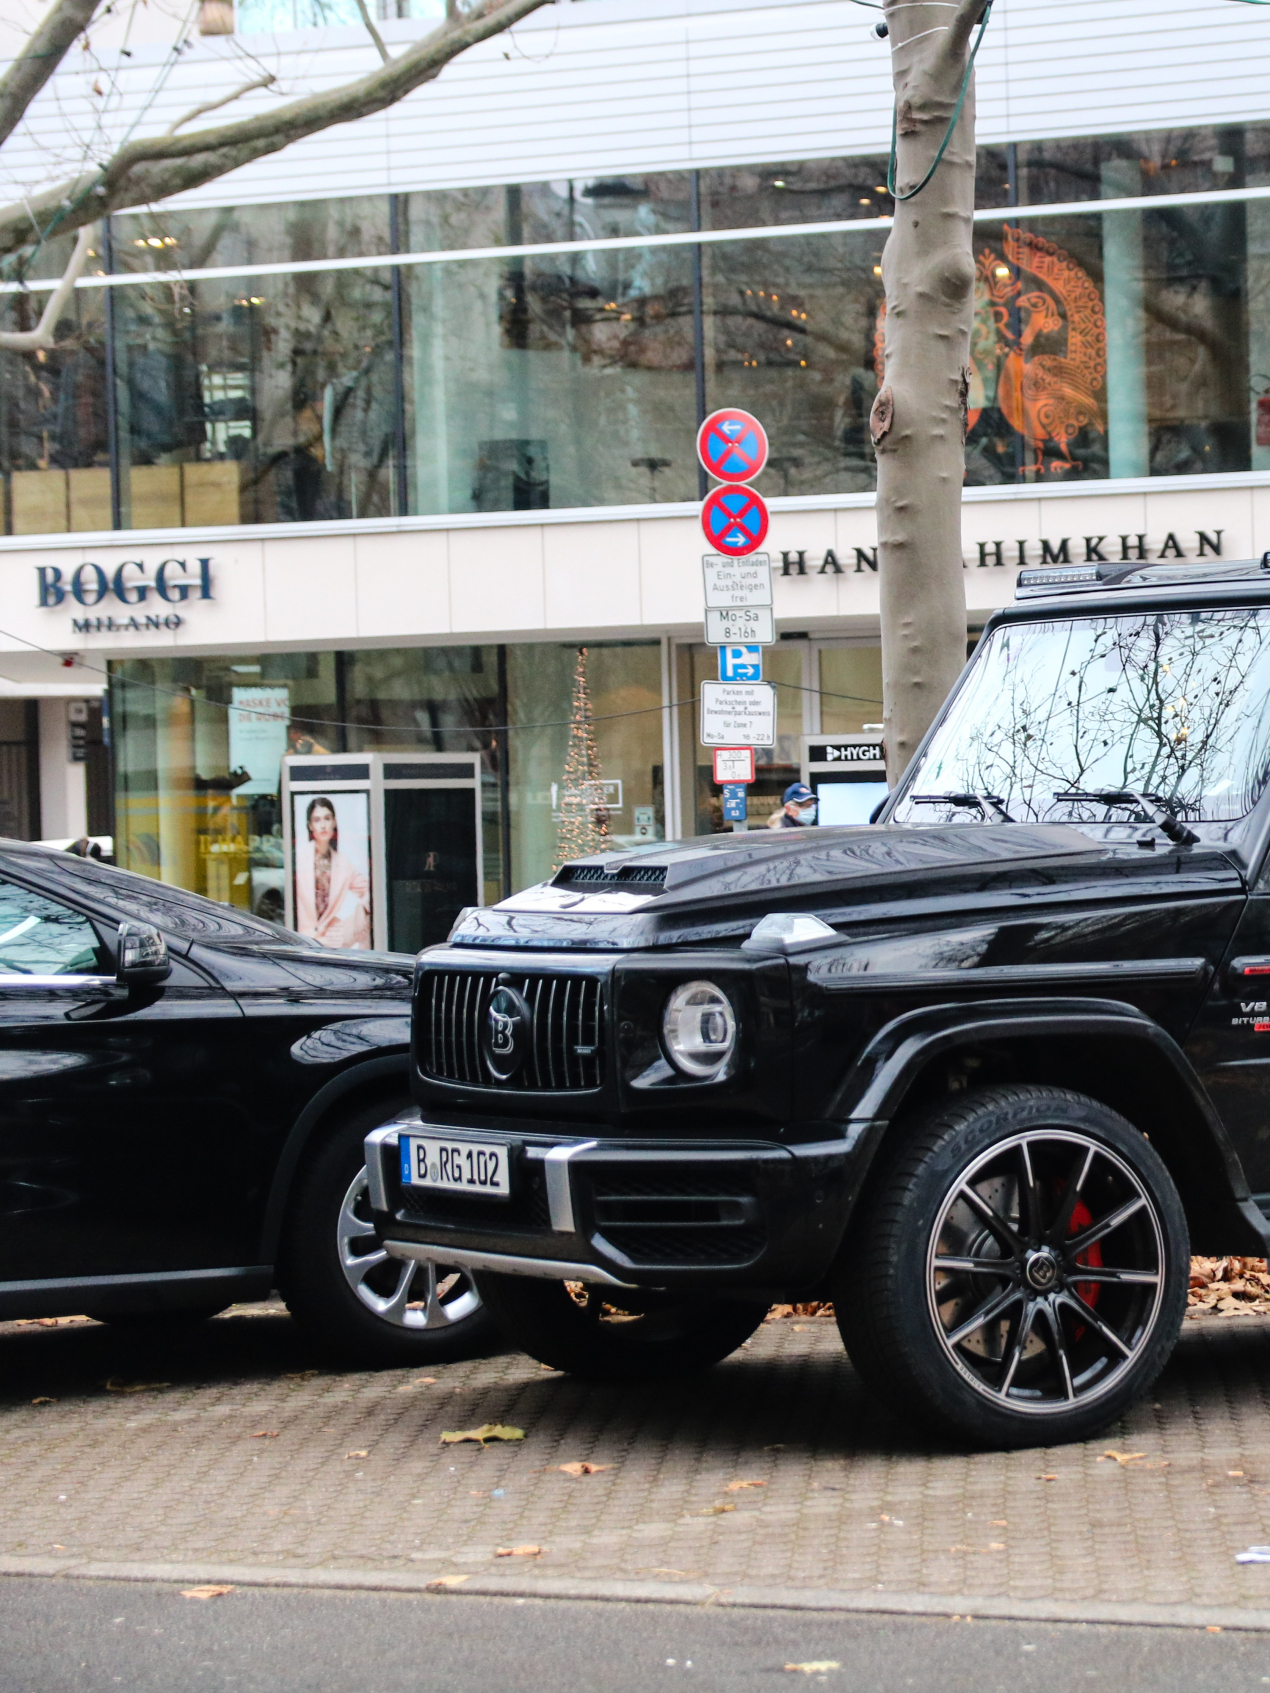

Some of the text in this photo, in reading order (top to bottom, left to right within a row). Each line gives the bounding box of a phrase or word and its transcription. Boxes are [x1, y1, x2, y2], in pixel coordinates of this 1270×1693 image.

[780, 529, 1225, 576] HAN HIMKHAN
[717, 570, 758, 580] Ein- und
[35, 557, 215, 608] BOGGI
[712, 582, 765, 593] Aussteigen
[731, 594, 747, 602] frei
[719, 610, 759, 622] Mo-Sa
[71, 613, 183, 634] MILANO
[724, 627, 756, 639] 8-16h
[841, 746, 880, 760] HYGH
[1240, 1001, 1268, 1012] V8
